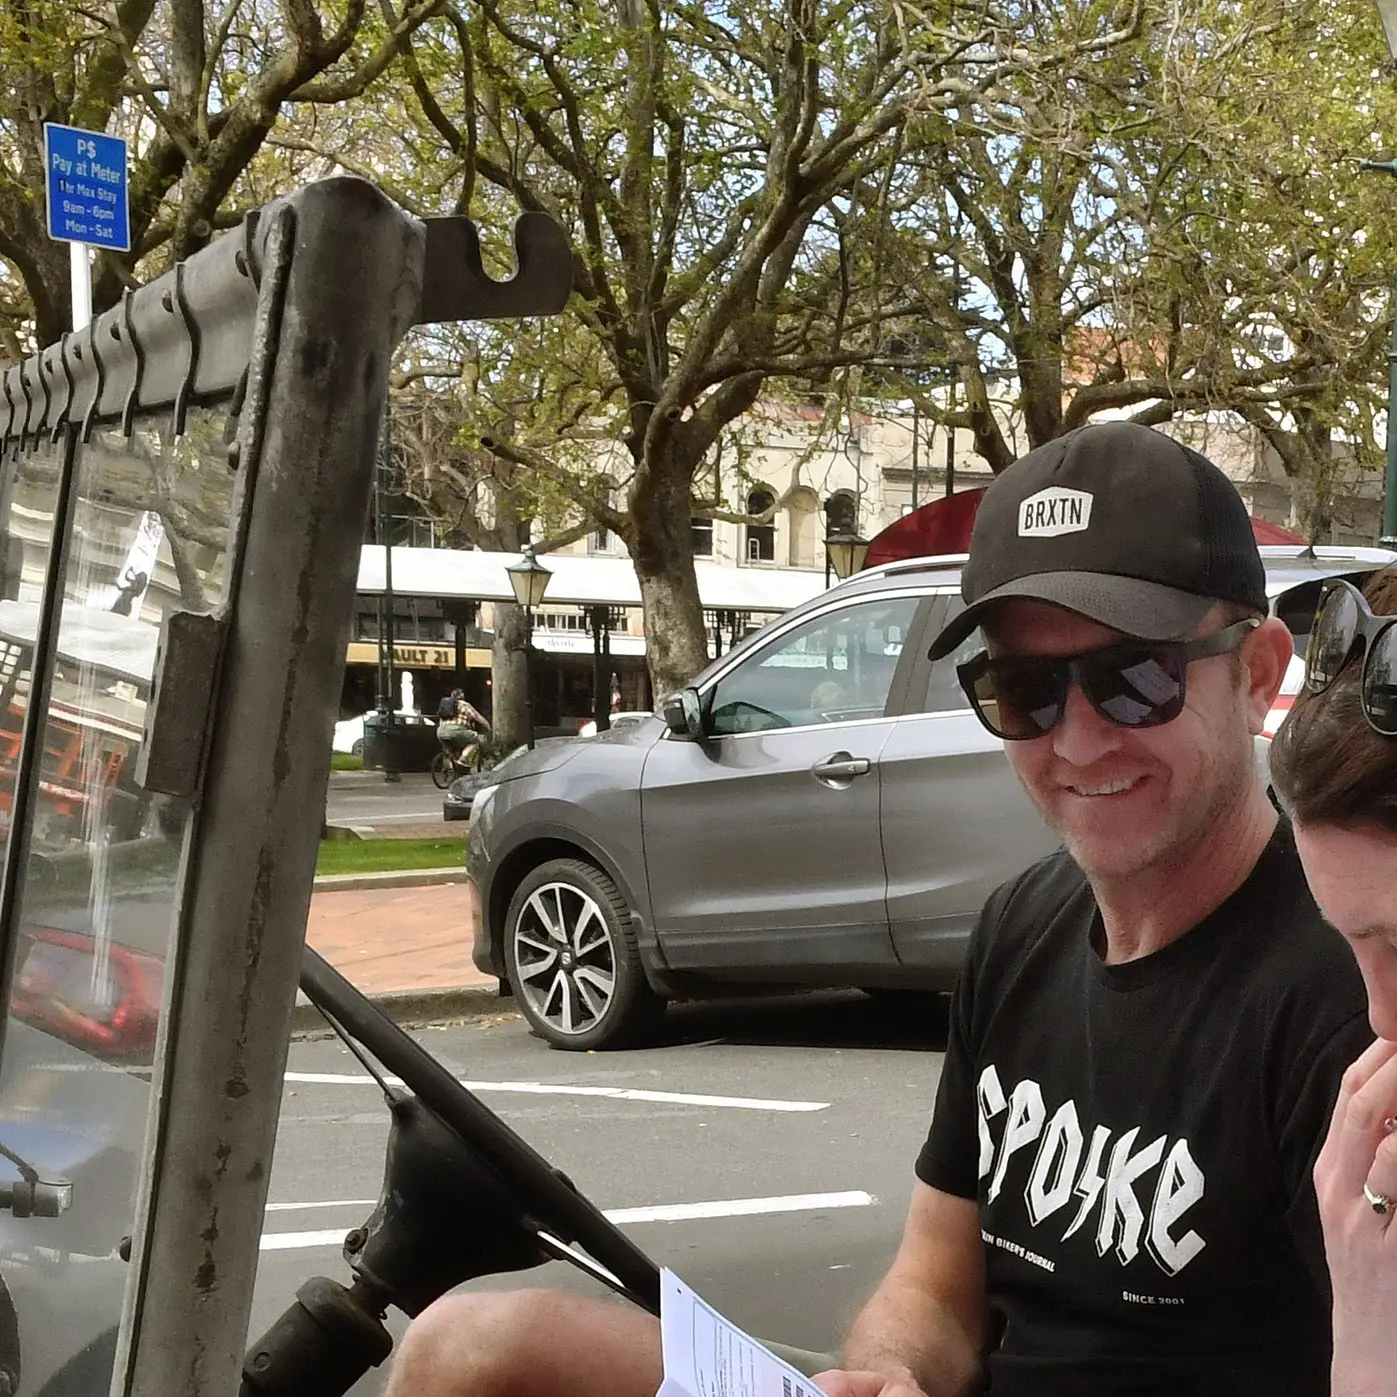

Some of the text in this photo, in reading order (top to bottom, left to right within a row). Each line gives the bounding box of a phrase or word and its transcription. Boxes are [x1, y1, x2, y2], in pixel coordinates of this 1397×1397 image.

[77, 139, 96, 159] P$
[52, 153, 120, 183] Pay at Meter
[77, 184, 95, 198] Max
[98, 187, 117, 204] Stay
[63, 200, 84, 214] 9am
[65, 219, 87, 233] Mon
[95, 224, 113, 238] Sat
[1024, 498, 1083, 531] BRXTN
[434, 651, 449, 664] 21
[1025, 1250, 1055, 1272] JOURNAL
[1122, 1290, 1156, 1304] SINCE
